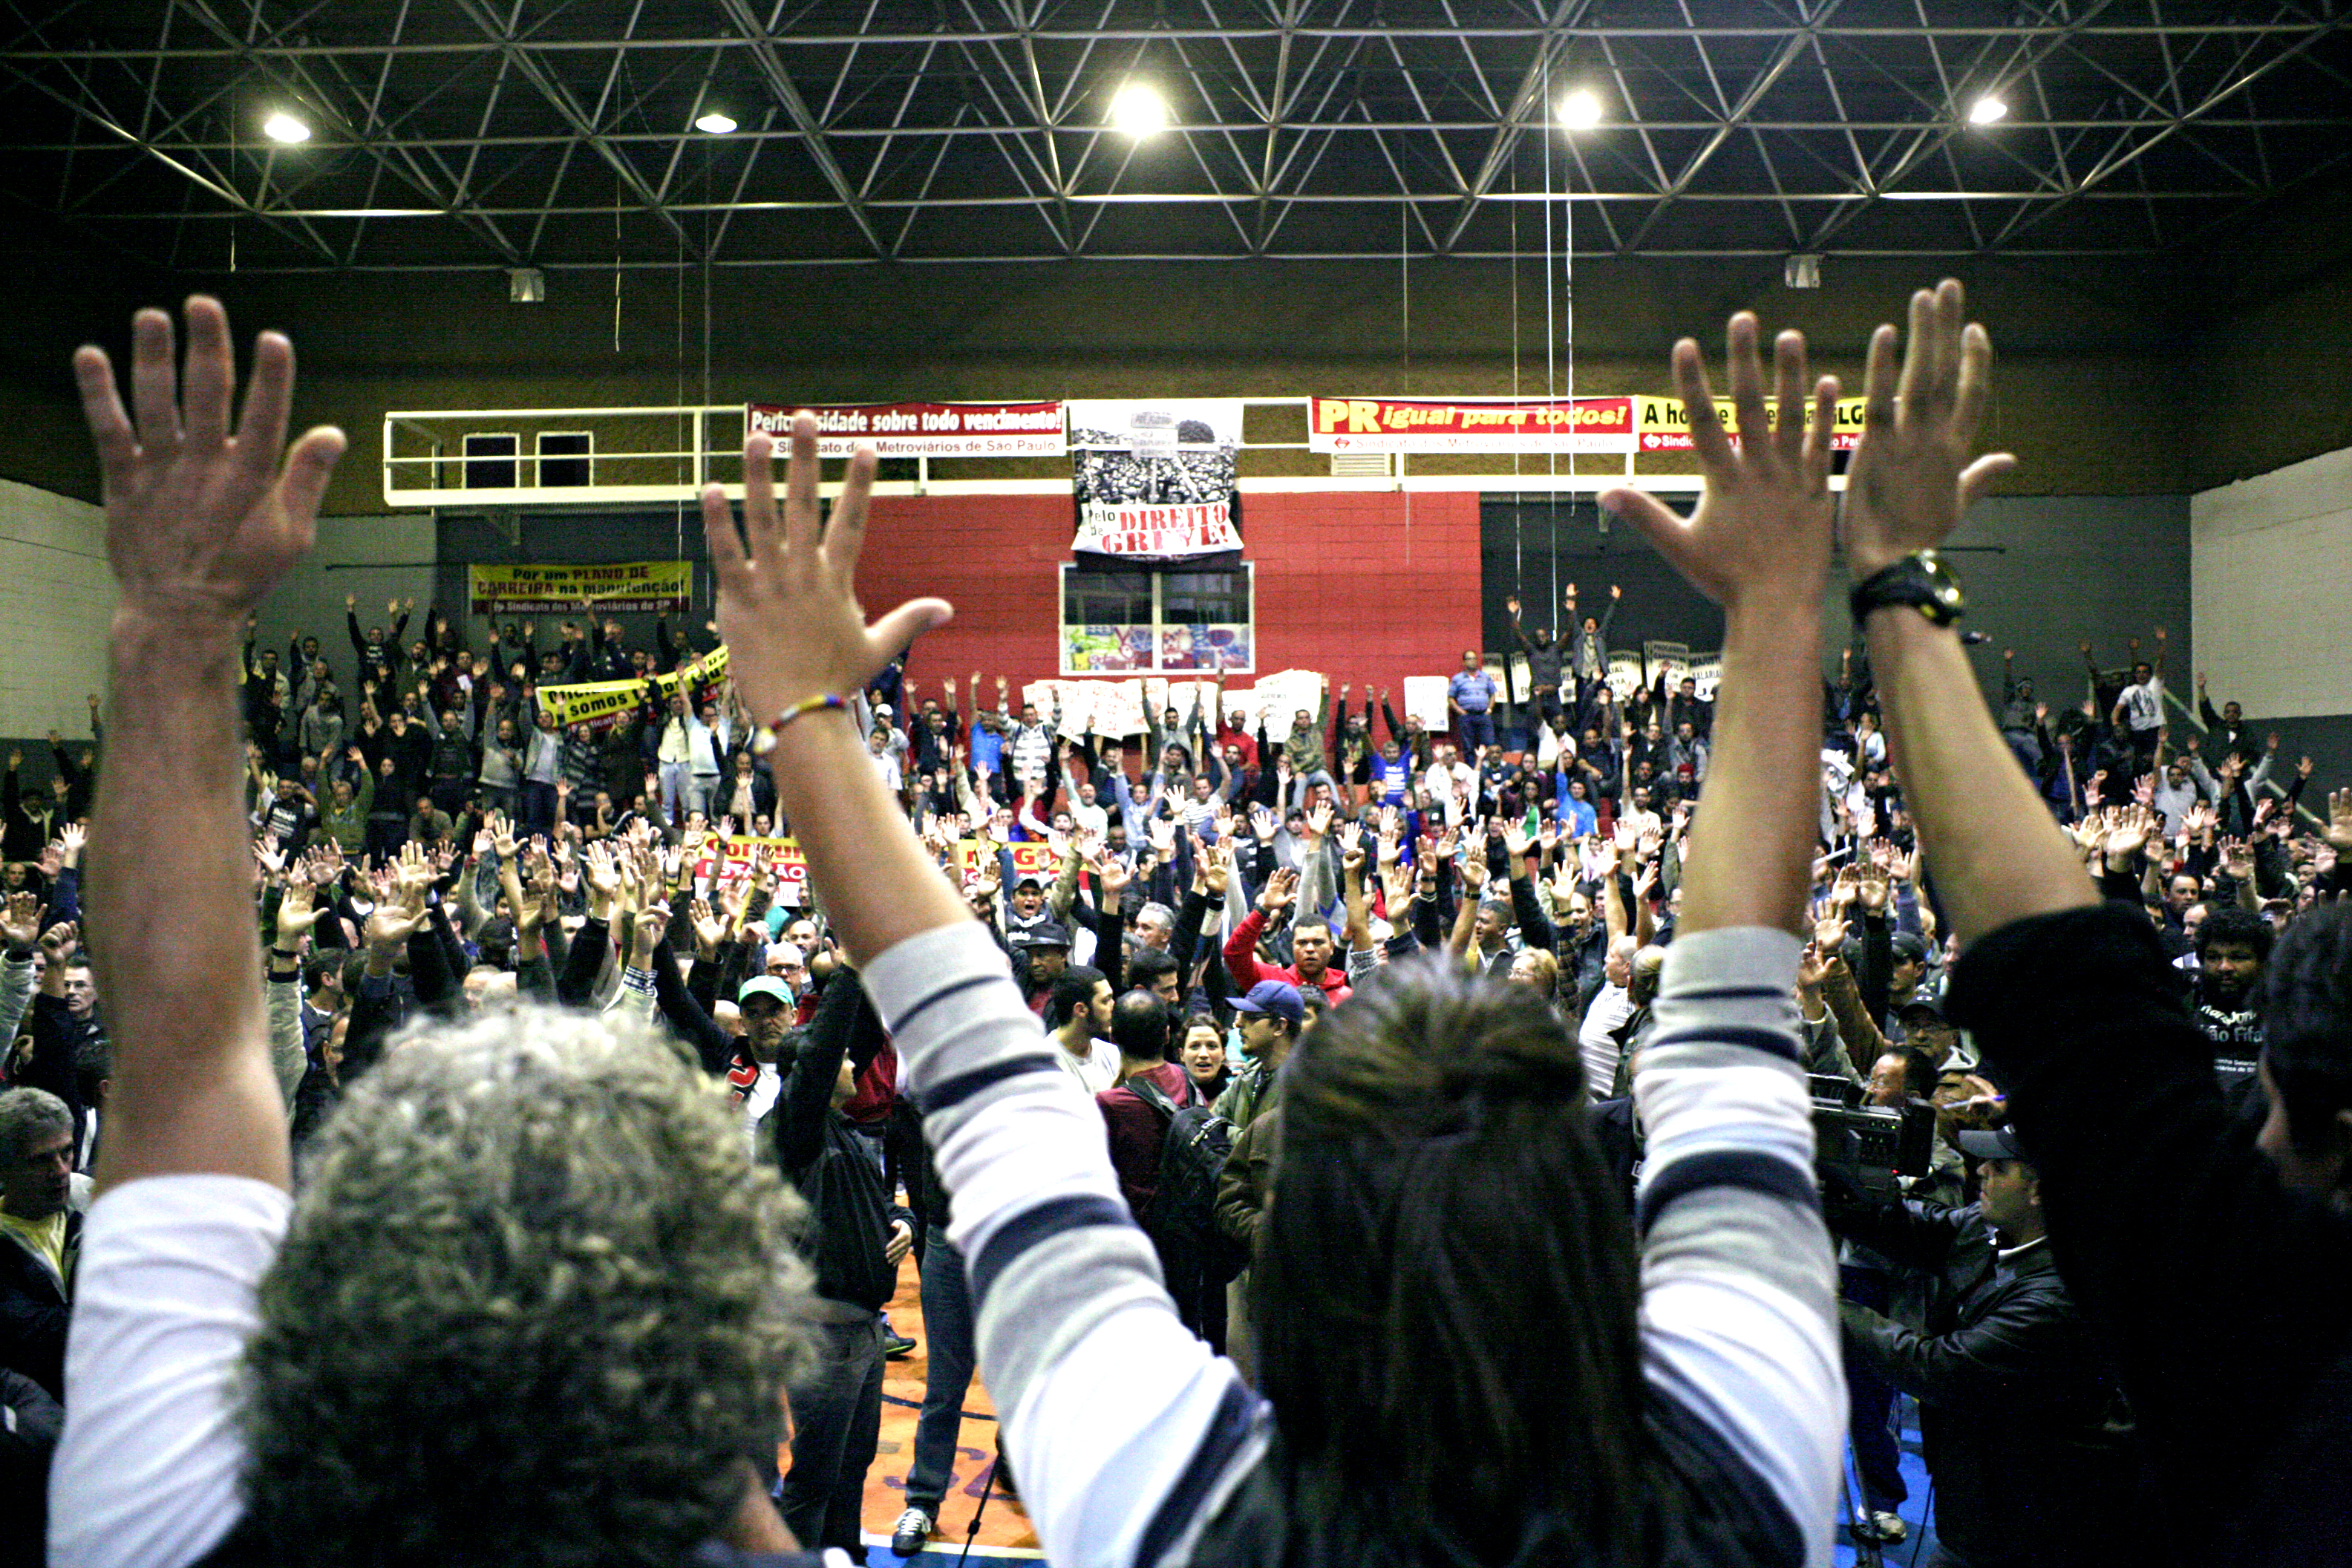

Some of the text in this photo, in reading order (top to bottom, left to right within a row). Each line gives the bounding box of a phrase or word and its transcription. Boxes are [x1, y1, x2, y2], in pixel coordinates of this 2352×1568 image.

[751, 408, 1062, 432] Pericsidade sobre todo vencimento!
[1319, 400, 1627, 432] PR igual para todos!
[1644, 403, 1659, 424] A
[777, 441, 842, 453] Sicato
[876, 440, 961, 453] Metroviários
[966, 440, 981, 451] de
[987, 440, 1012, 451] São
[1018, 440, 1056, 451] Paulo
[1120, 504, 1227, 532] DIREITO
[1102, 524, 1229, 552] GREVE!
[513, 568, 538, 580] Por
[572, 568, 623, 580] PLANO
[629, 566, 649, 578] DE
[477, 581, 554, 595] CARREIRA
[559, 584, 578, 595] na
[569, 693, 628, 717] somos
